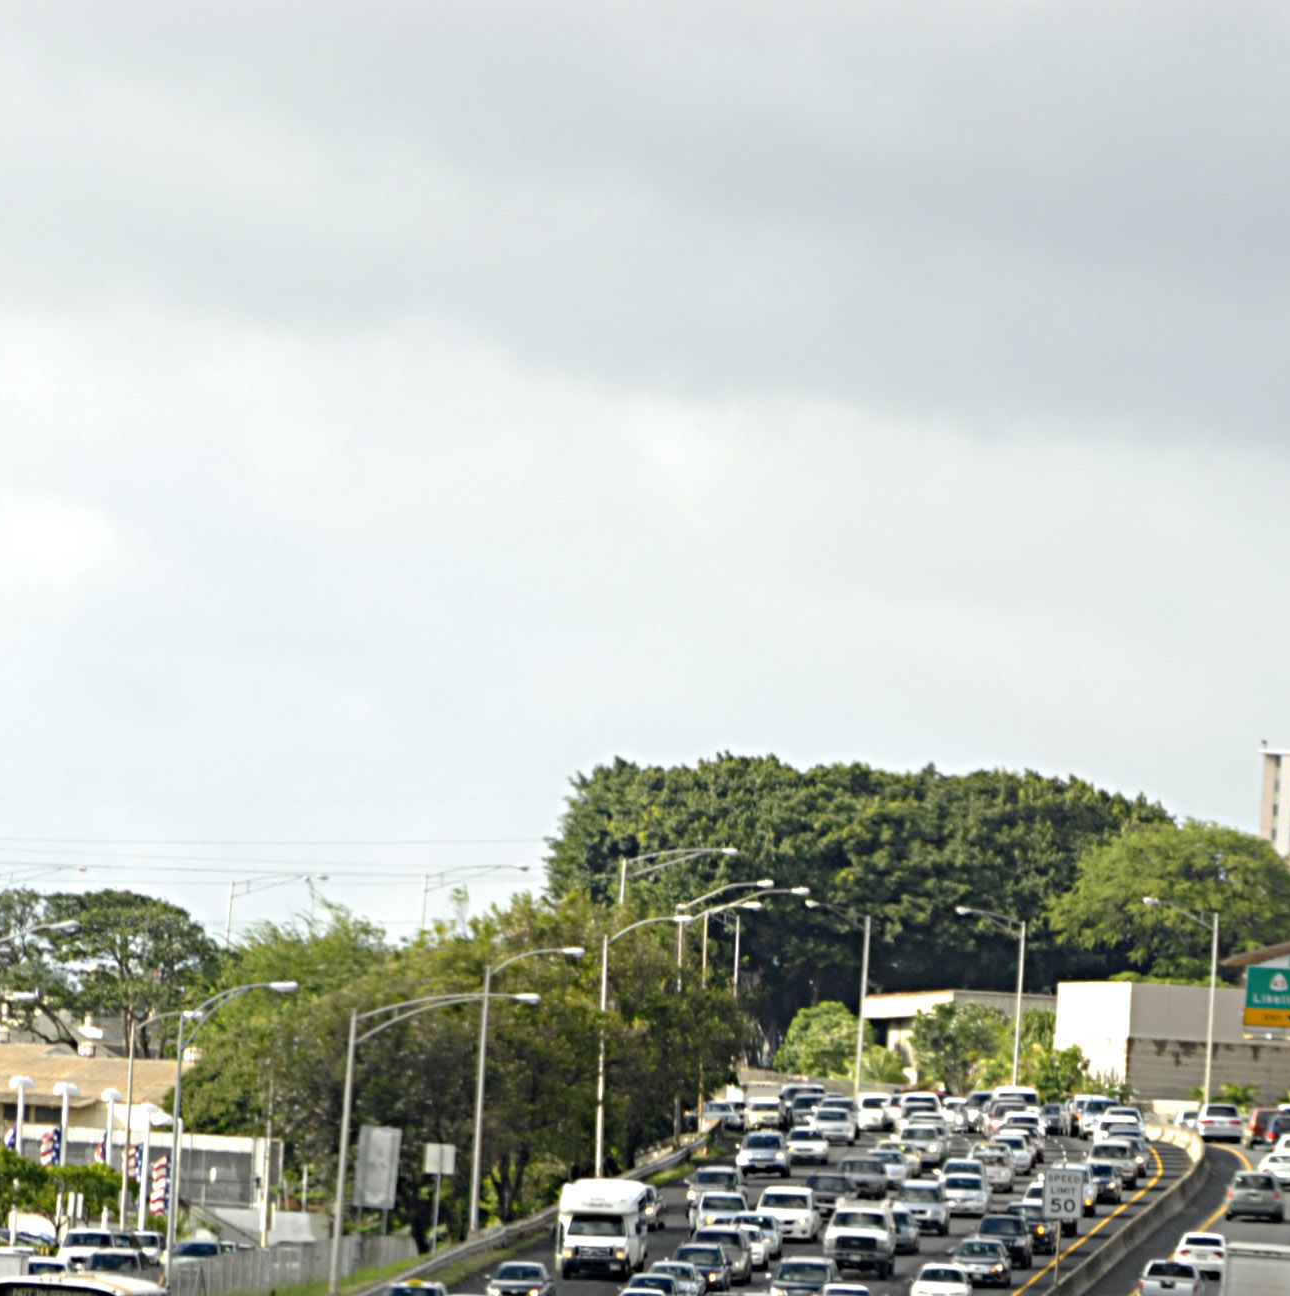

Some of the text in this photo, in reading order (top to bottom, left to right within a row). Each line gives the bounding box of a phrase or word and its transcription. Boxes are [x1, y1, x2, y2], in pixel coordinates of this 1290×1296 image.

[1049, 1173, 1081, 1184] SPEED
[1050, 1186, 1077, 1196] LIMIT
[1051, 1198, 1076, 1214] 50
